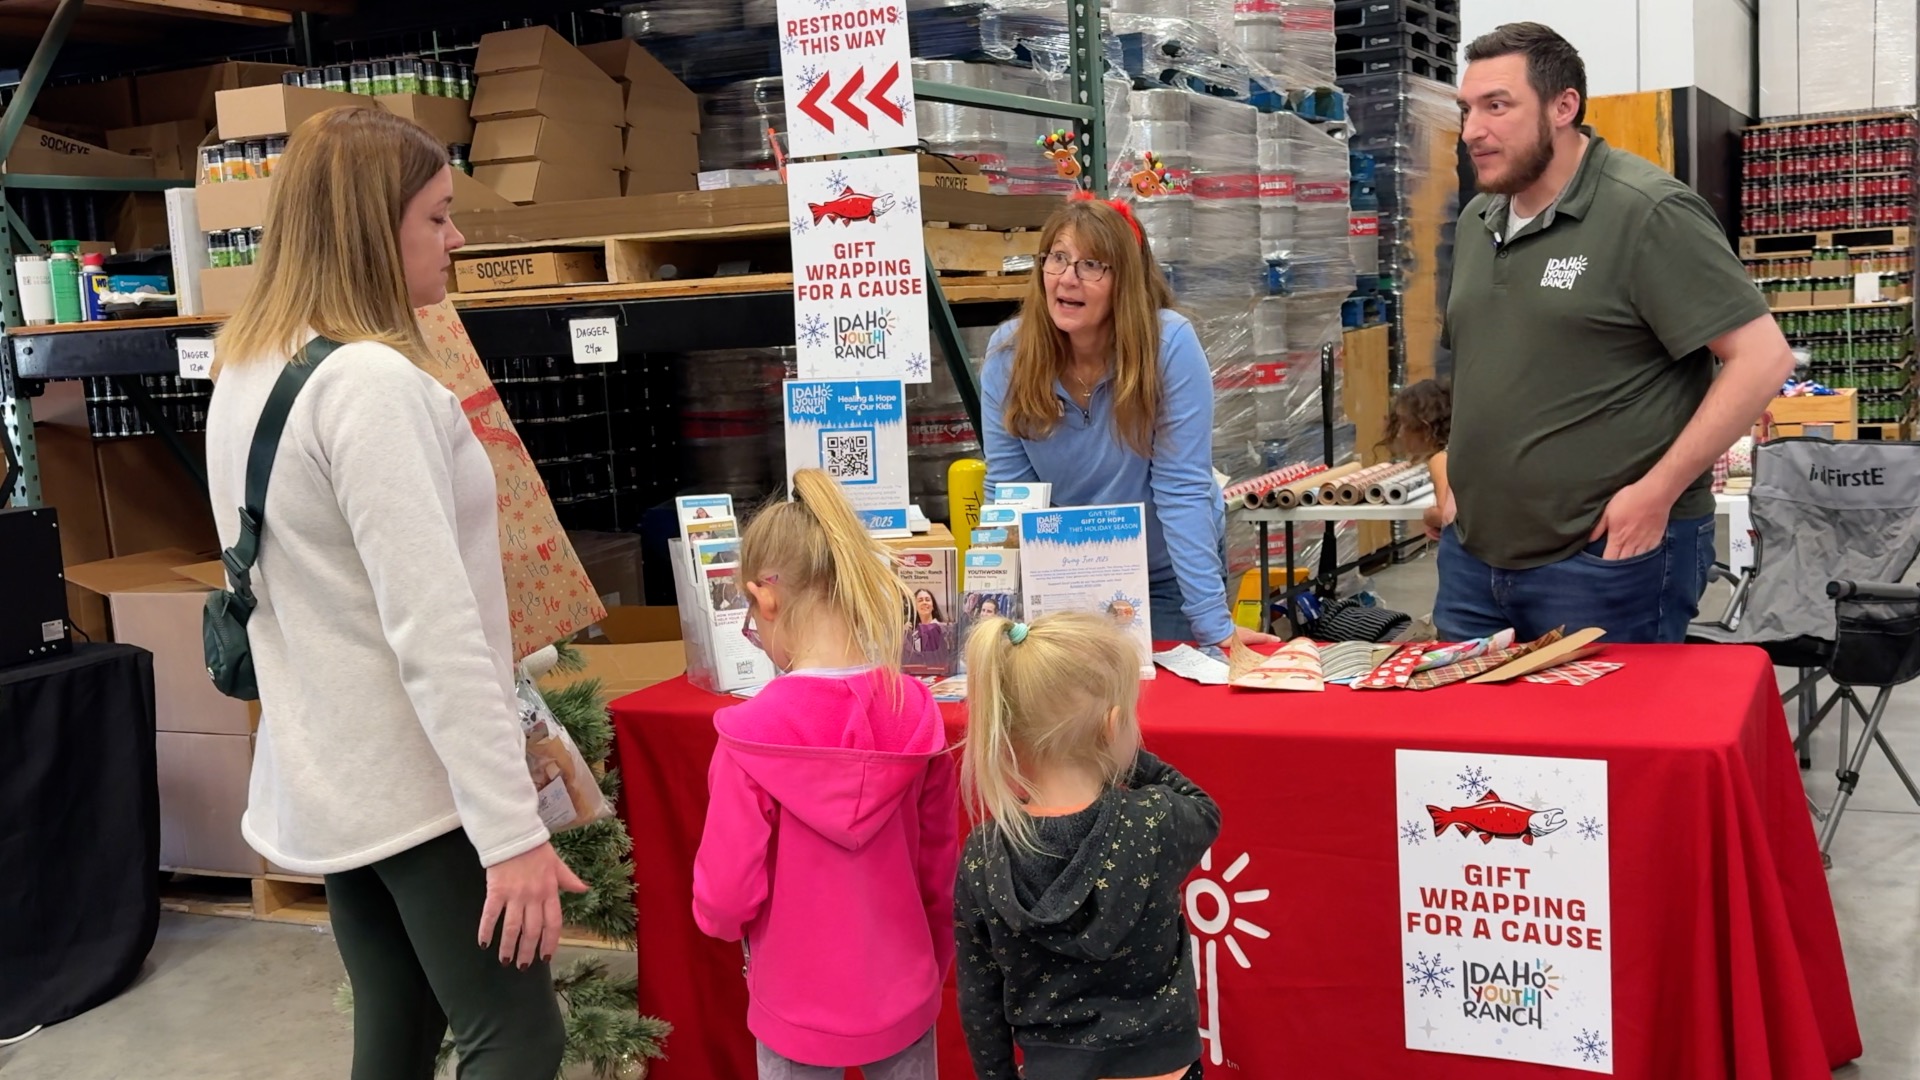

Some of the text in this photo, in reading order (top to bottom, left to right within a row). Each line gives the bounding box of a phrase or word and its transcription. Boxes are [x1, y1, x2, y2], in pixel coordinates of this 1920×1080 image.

[787, 6, 897, 37] RESTROOMS
[799, 28, 886, 56] THIS WAY
[935, 176, 968, 190] SOCKEYE
[834, 241, 876, 260] GIFT
[476, 258, 534, 279] SOCKEYE
[806, 259, 911, 281] WRAPPING
[1544, 256, 1582, 273] IDAHO
[1548, 269, 1576, 278] YOUTH
[798, 278, 922, 301] FOR A CAUSE
[1540, 275, 1575, 290] RANCH
[576, 326, 610, 338] DAGGER
[834, 310, 888, 340] IDAHO
[839, 330, 882, 346] YOUTH
[182, 350, 210, 360] DAGGER
[834, 338, 886, 360] RANCH
[792, 384, 828, 402] IDAHO
[795, 398, 824, 407] YOUTH
[838, 395, 867, 404] Healing
[876, 394, 896, 402] Hope
[792, 402, 827, 414] RANCH
[844, 404, 859, 412] For
[860, 402, 874, 411] Our
[962, 491, 980, 525] THE
[870, 516, 894, 528] 2025
[1464, 864, 1530, 890] GIFT
[1420, 887, 1586, 922] WRAPPING
[1407, 912, 1602, 950] FOR A CAUSE
[1463, 960, 1546, 992] IDAHO
[1470, 984, 1536, 1007] YOUTH
[1463, 996, 1542, 1030] RANCH
